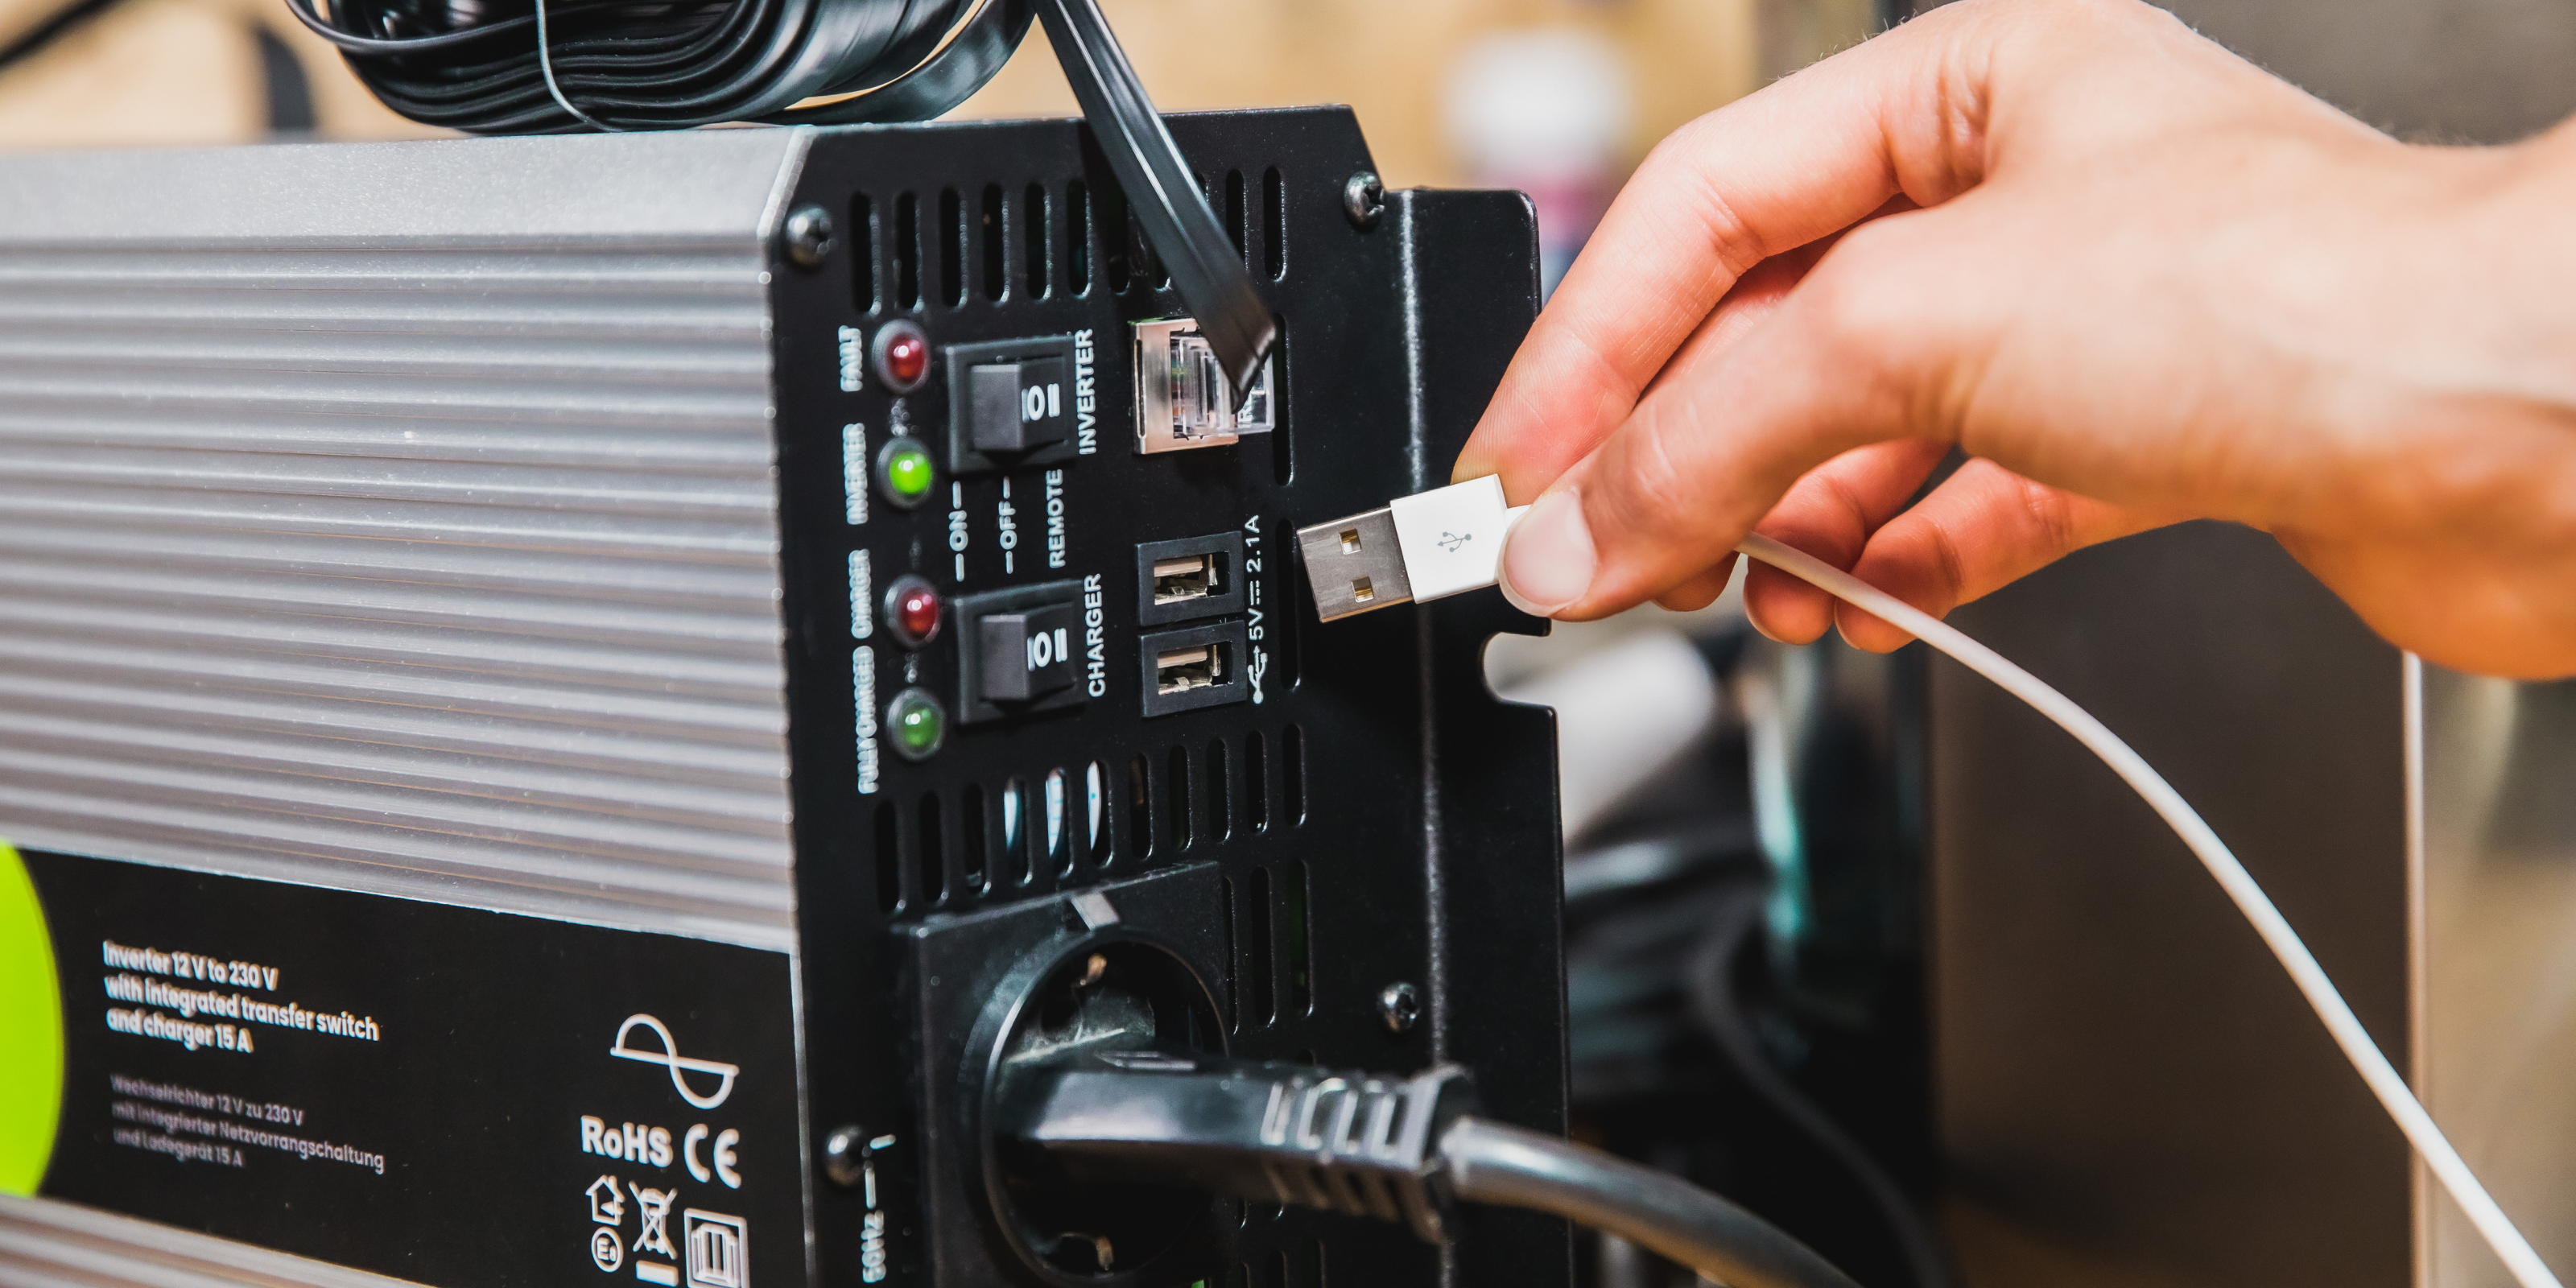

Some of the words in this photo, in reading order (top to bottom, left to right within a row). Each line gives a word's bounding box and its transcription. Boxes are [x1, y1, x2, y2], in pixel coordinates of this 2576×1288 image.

[1075, 328, 1096, 455] INVERTER
[948, 510, 968, 551] ON
[998, 501, 1018, 550] OFF
[1046, 469, 1066, 568] REMOTE
[1244, 514, 1262, 574] 2.1A
[1084, 573, 1106, 697] CHARGER
[103, 939, 171, 975] Inverter
[171, 952, 190, 977] 12
[191, 956, 208, 980] V
[208, 959, 226, 984] to
[229, 960, 260, 987] 230
[262, 967, 279, 991] V
[105, 973, 144, 1002] with
[145, 977, 241, 1019] integrated
[242, 996, 315, 1031] transfer
[316, 1010, 380, 1042] switch
[106, 1007, 146, 1035] and
[144, 1010, 213, 1051] charger
[215, 1024, 234, 1050] 15
[237, 1028, 254, 1053] A
[216, 1093, 232, 1114] 12
[233, 1096, 242, 1116] V
[246, 1102, 262, 1119] zu
[264, 1103, 290, 1124] 230
[292, 1109, 304, 1126] V
[215, 1146, 230, 1166] 15
[233, 1150, 243, 1167] A
[219, 1121, 385, 1174] Netzvorrangschaltung
[580, 1115, 673, 1167] RoHS
